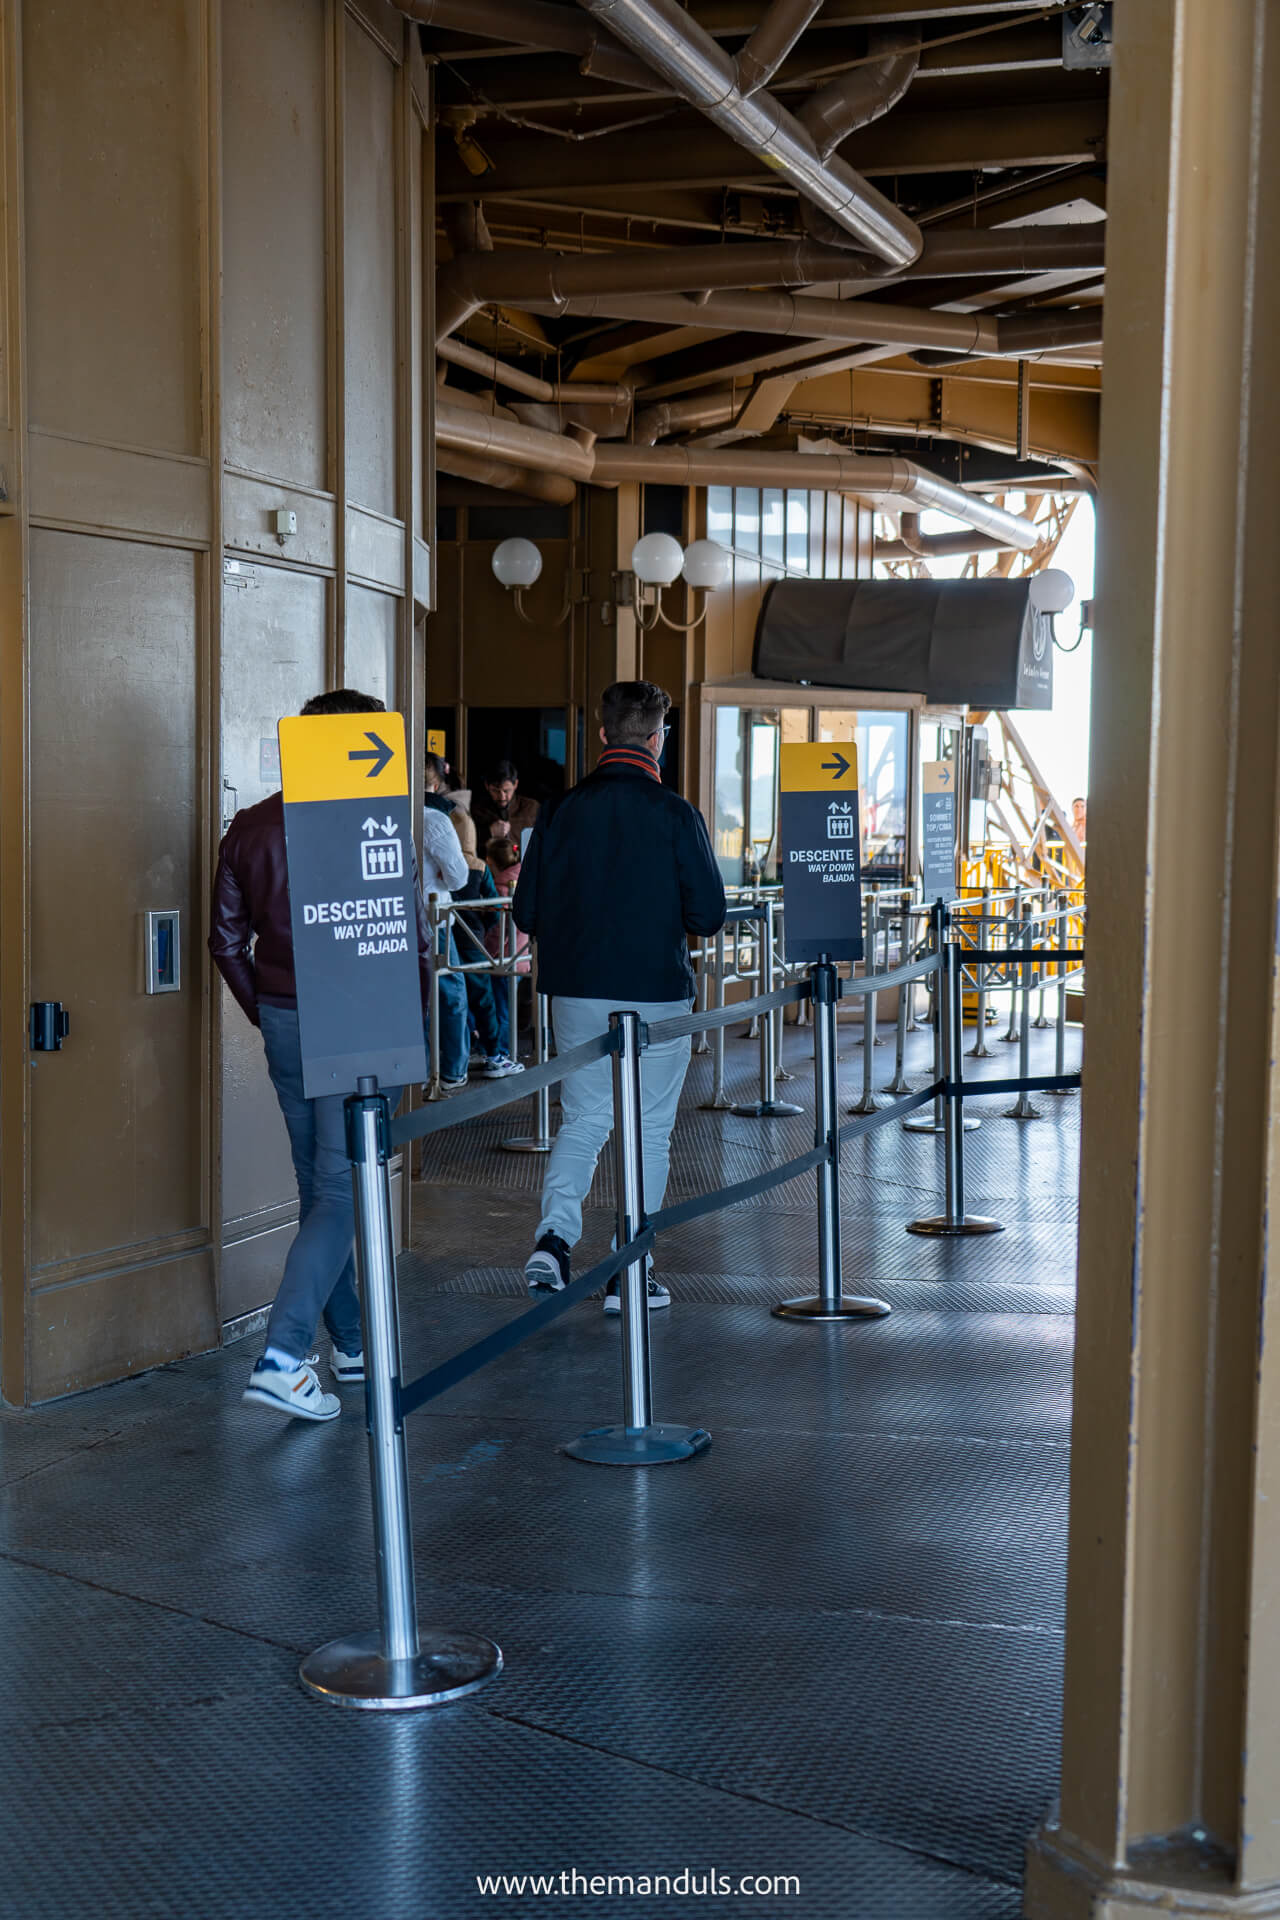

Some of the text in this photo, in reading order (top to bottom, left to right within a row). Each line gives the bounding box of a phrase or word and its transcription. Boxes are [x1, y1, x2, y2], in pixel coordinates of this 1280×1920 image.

[790, 849, 854, 863] DESCENTE
[808, 863, 855, 873] WAY DOWN
[823, 874, 855, 883] BAJADA
[303, 896, 405, 925] DESCENTE
[334, 920, 407, 940] WAY DOWN
[358, 938, 408, 956] BAJADA
